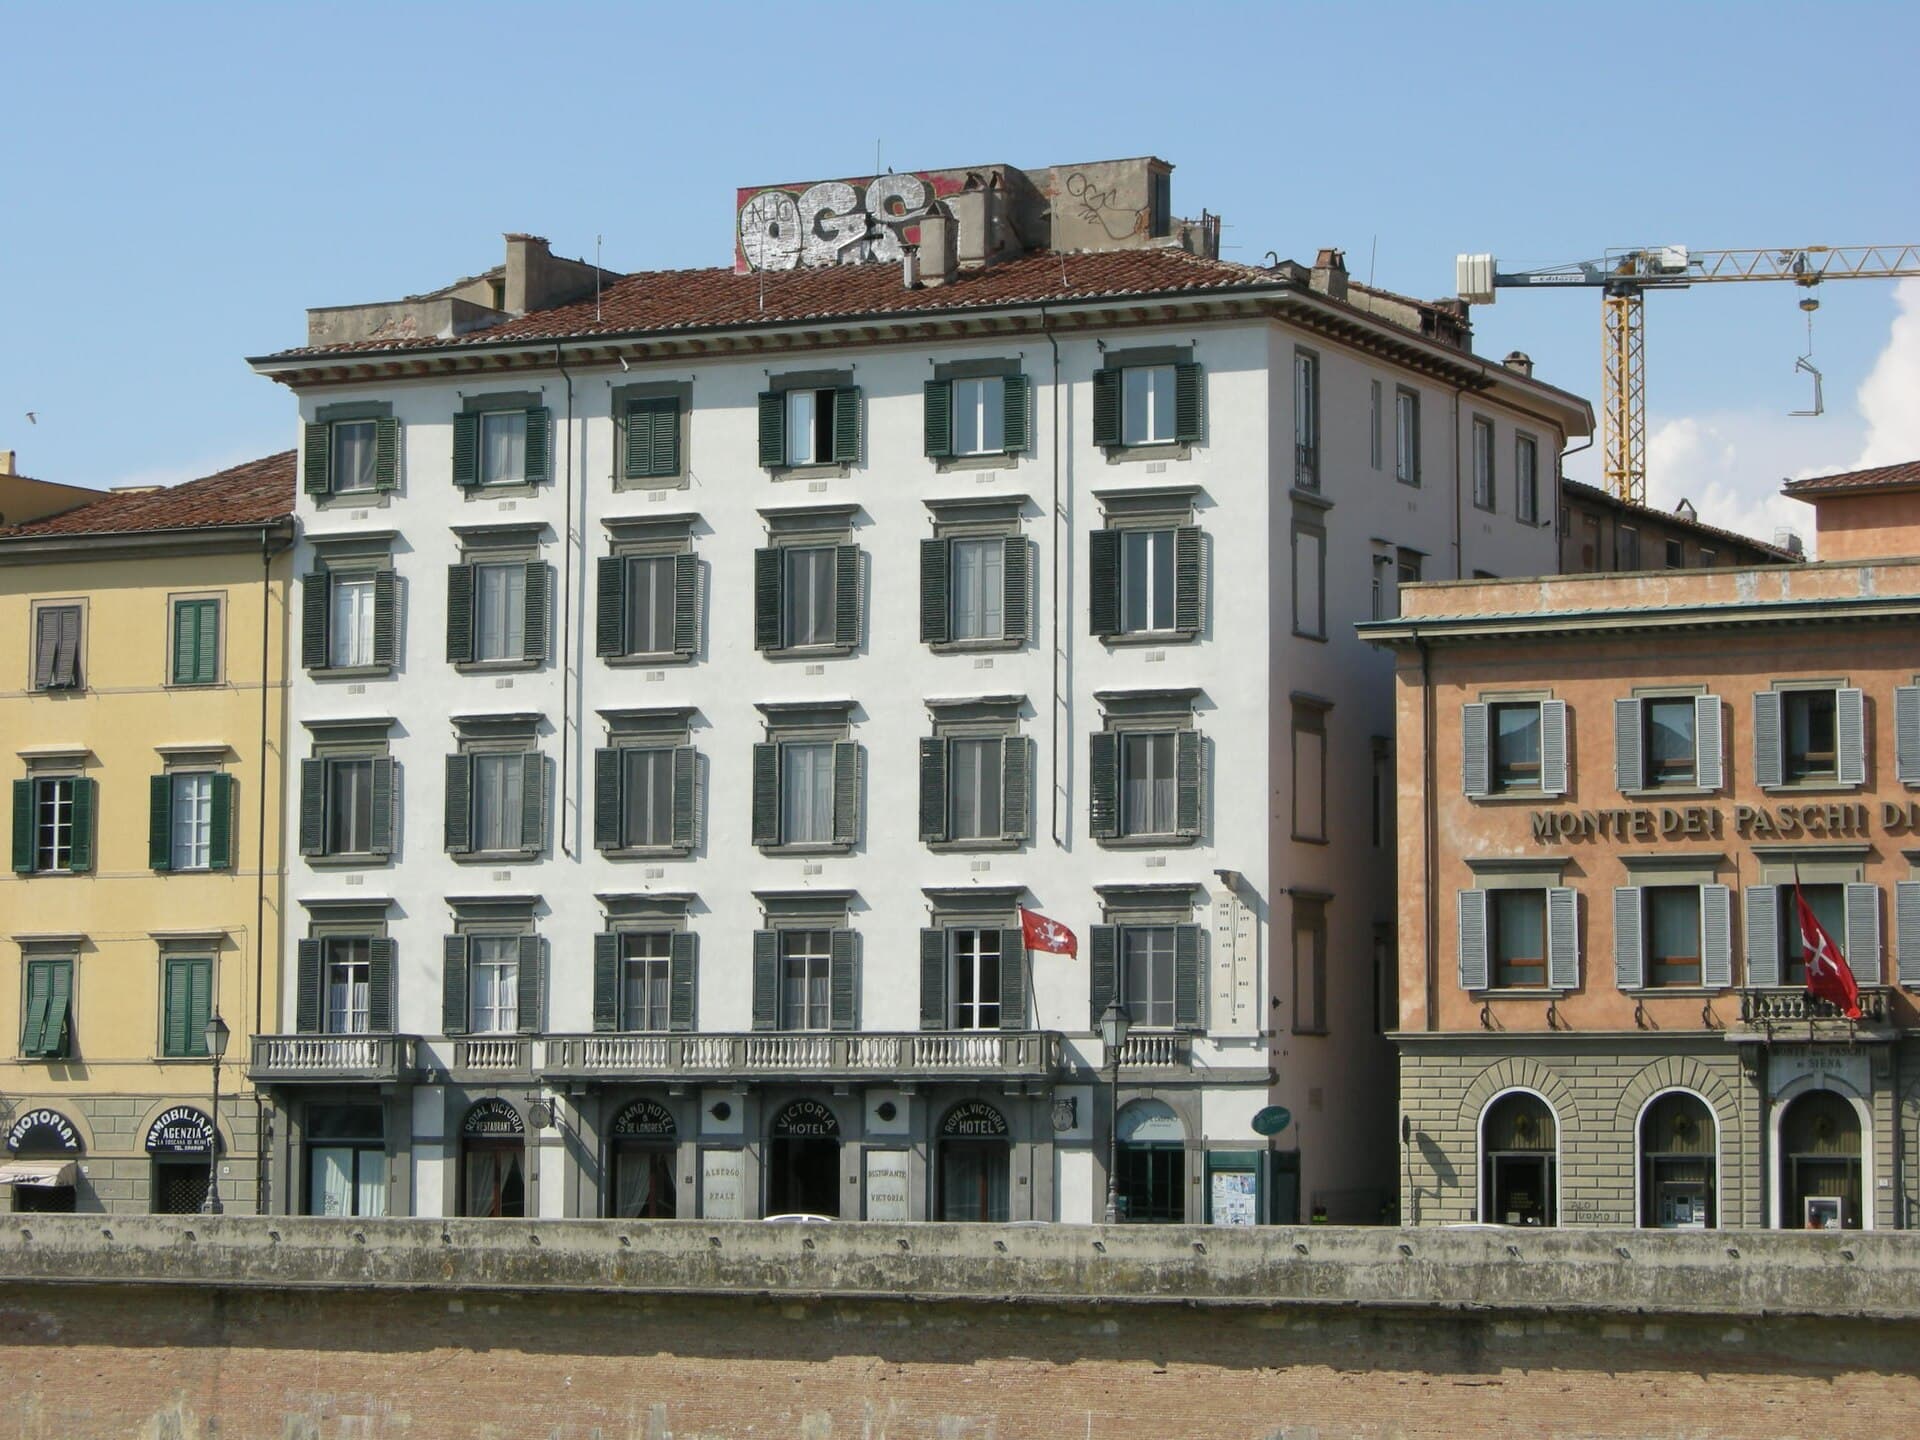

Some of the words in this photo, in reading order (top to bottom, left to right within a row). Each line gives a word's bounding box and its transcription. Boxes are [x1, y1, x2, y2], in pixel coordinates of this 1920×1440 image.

[1530, 808, 1648, 836] MONTE
[1659, 806, 1715, 833] DEI
[1734, 803, 1861, 831] PASCHI
[1881, 801, 1912, 828] DI
[9, 1111, 77, 1148] PHOTOPLAY
[465, 1106, 488, 1131] ROYAL
[490, 1103, 524, 1133] VICTORIA
[476, 1121, 511, 1132] RESTAURANT
[615, 1103, 644, 1133] GRAND
[647, 1103, 674, 1132] HOTEL
[778, 1103, 836, 1130] VICTORIA
[789, 1123, 826, 1135] HOTEL
[944, 1106, 970, 1133] ROYAL
[970, 1103, 1006, 1133] VICTORIA
[959, 1120, 996, 1134] HOTEL
[162, 1127, 202, 1139] AGENZIA
[705, 1168, 741, 1177] ALBERGO
